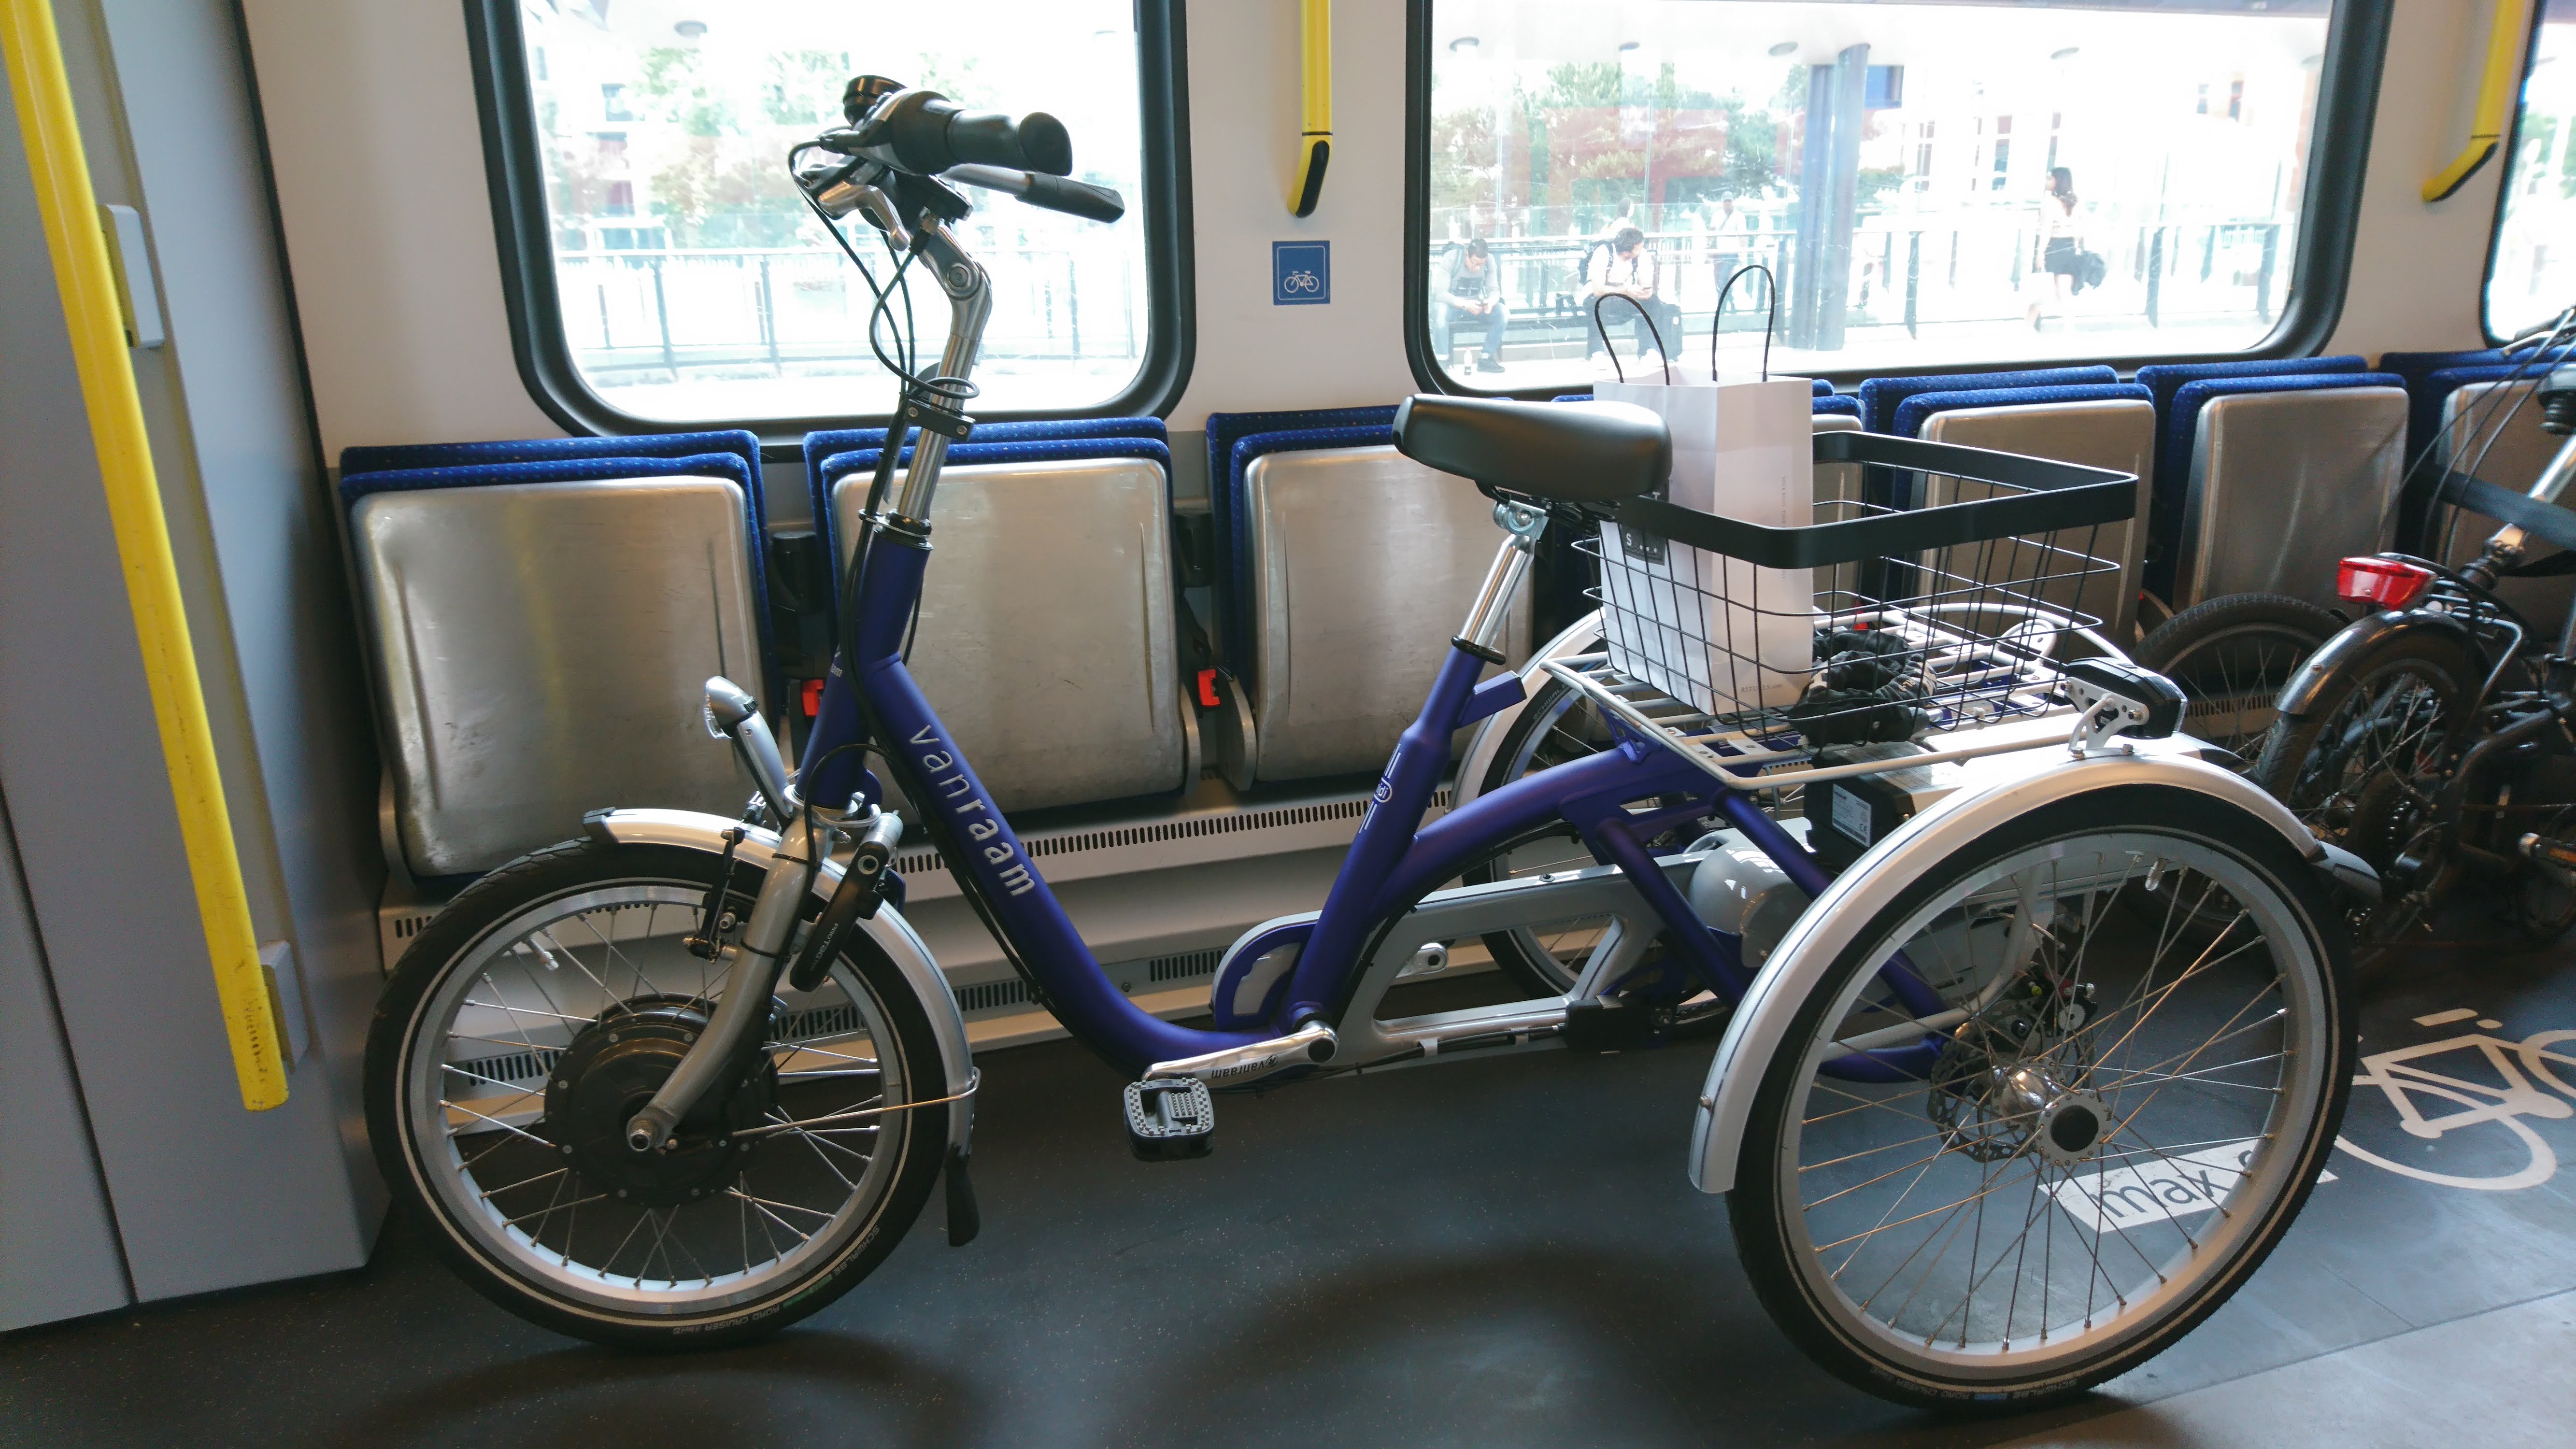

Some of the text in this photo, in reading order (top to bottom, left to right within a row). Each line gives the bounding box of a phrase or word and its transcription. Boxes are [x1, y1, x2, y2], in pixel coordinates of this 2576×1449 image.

[910, 724, 1035, 896] vanraam
[1211, 1061, 1264, 1079] vanraam
[2091, 1170, 2229, 1218] max
[834, 1224, 880, 1277] SCHWALBE
[705, 1316, 748, 1331] CRUISER
[753, 1305, 780, 1321] ROAD
